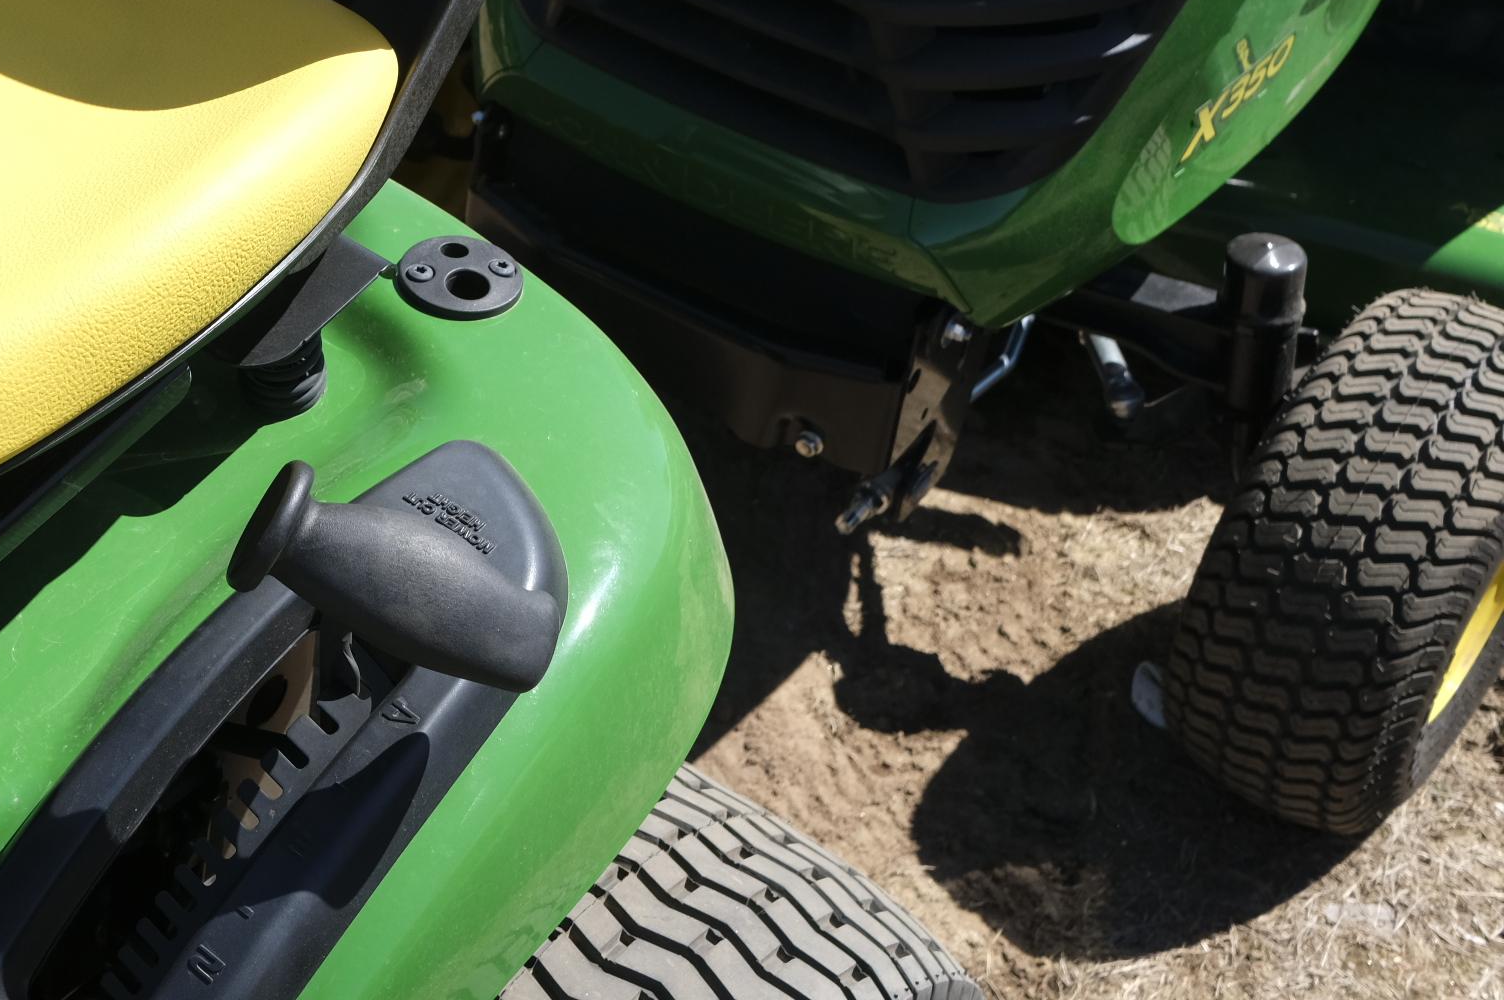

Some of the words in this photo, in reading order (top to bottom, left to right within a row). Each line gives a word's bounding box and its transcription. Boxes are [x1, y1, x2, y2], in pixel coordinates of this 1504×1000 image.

[1179, 33, 1296, 164] X350
[402, 490, 436, 516] CUT
[426, 491, 488, 532] HEIGHT
[433, 511, 497, 555] MOWER
